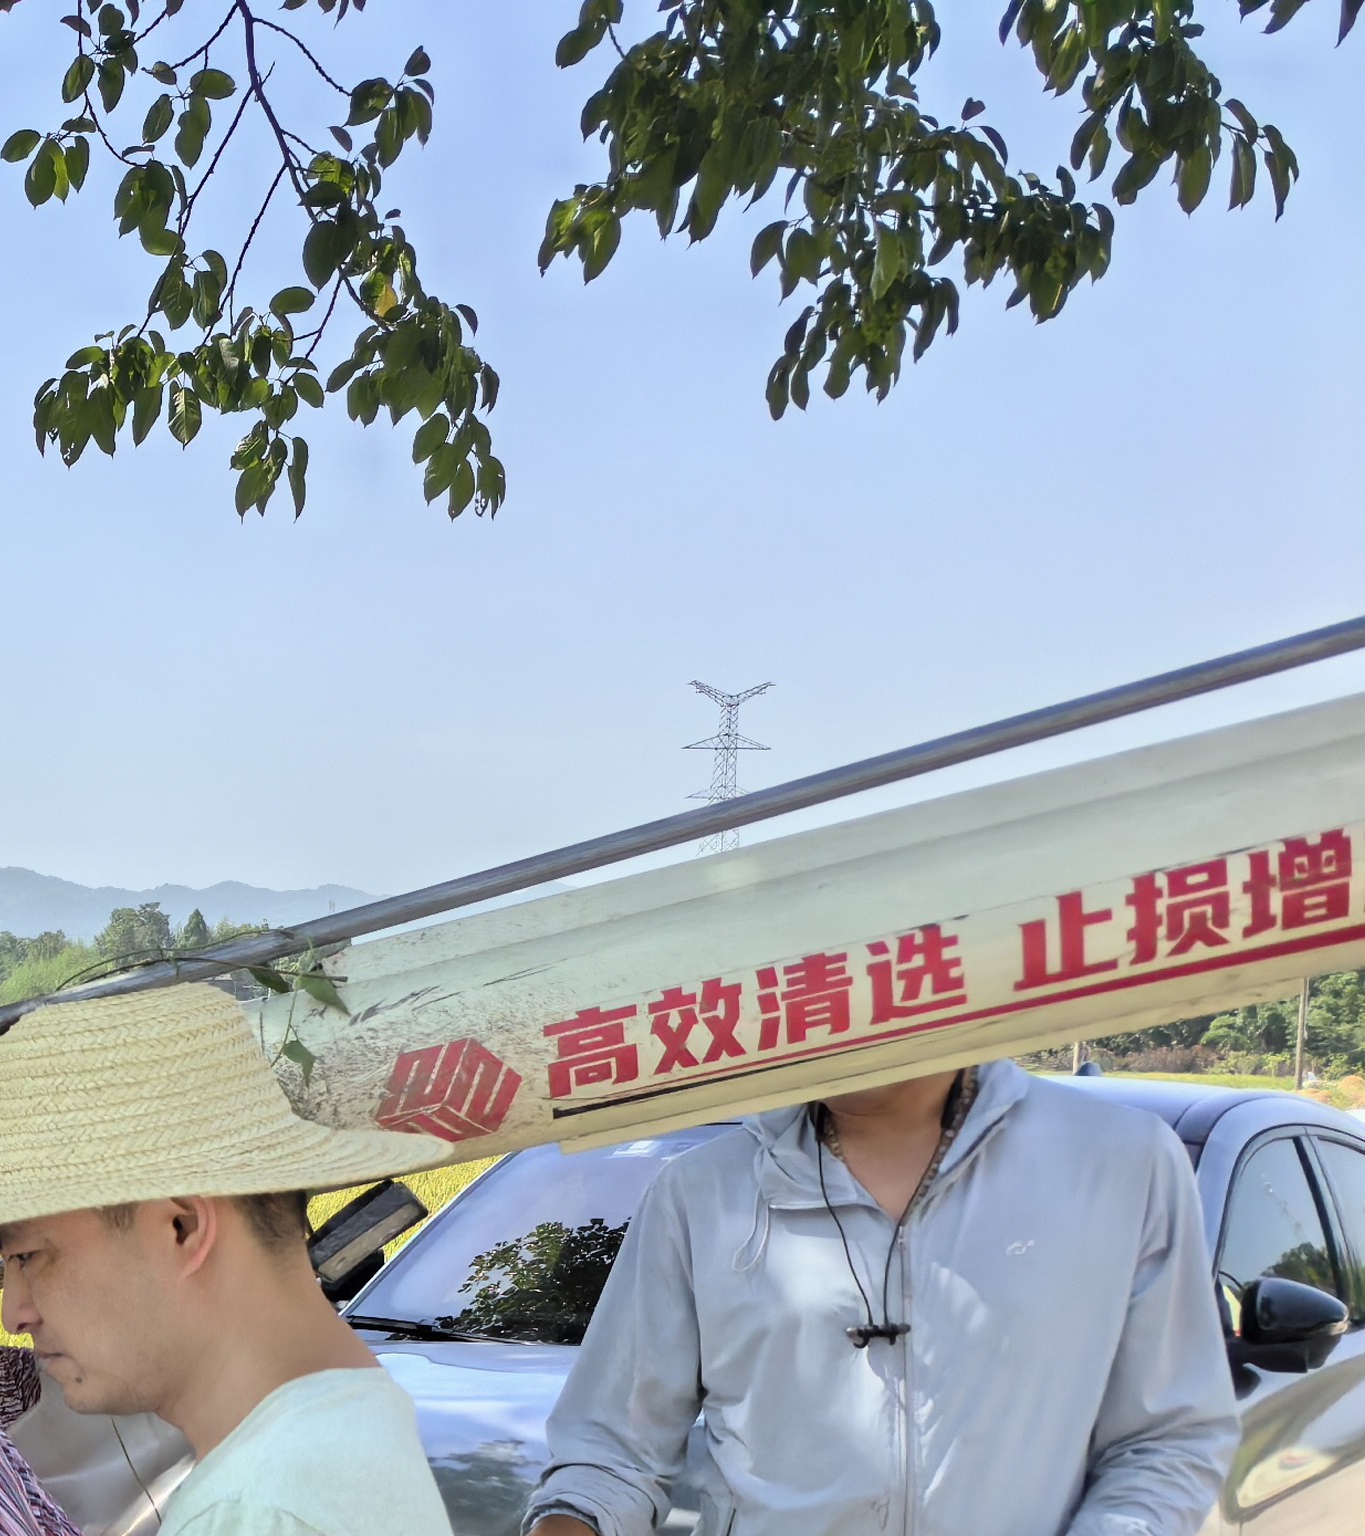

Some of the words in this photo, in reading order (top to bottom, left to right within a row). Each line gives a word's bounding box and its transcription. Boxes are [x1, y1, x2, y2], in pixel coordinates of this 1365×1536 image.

[542, 921, 968, 1100] 高效清选
[1014, 828, 1352, 993] 止损增
